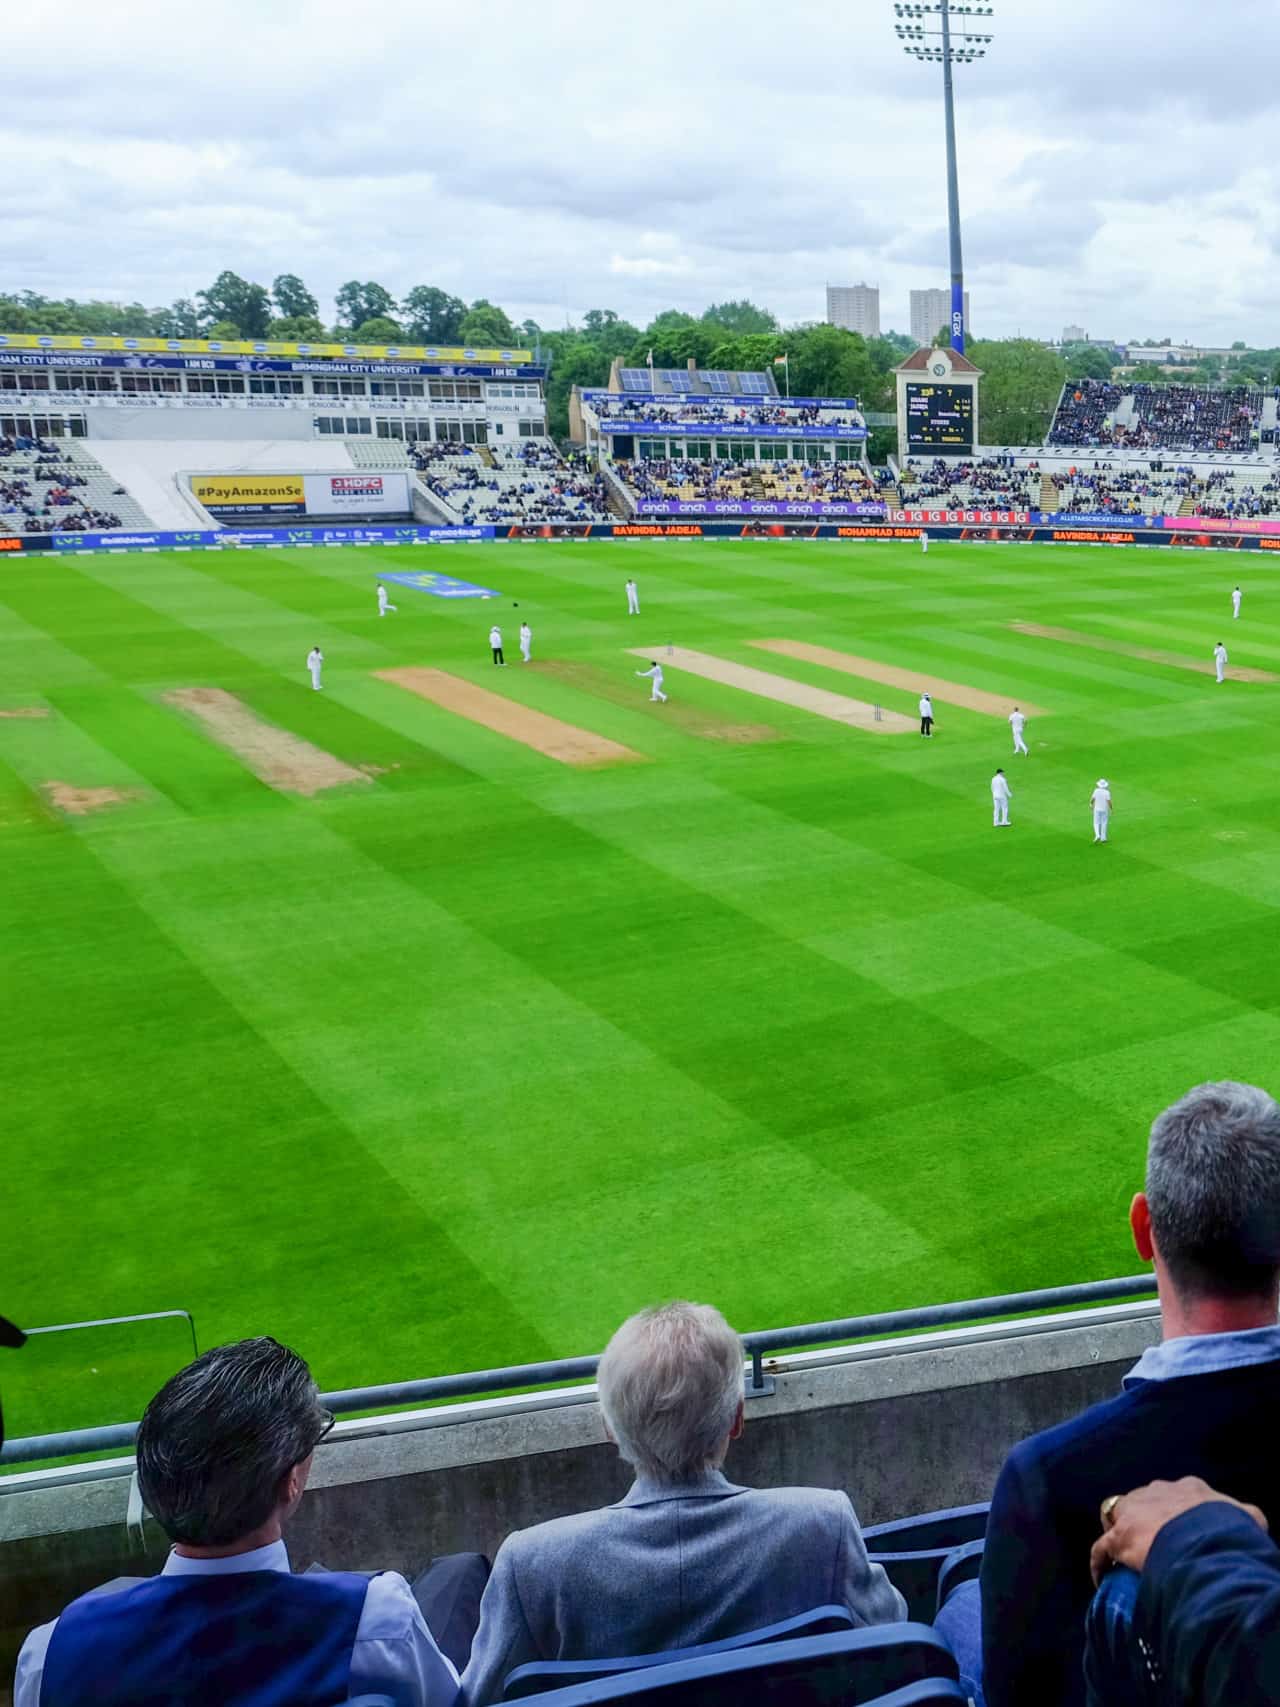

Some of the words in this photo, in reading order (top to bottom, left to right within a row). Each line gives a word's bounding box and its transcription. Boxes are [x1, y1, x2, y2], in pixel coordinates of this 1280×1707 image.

[952, 311, 962, 337] drax
[23, 356, 43, 365] CITY
[46, 356, 103, 366] UNIVERSITY
[291, 362, 348, 372] BIRMINGHAM
[350, 365, 370, 374] CITY
[371, 366, 421, 375] UNIVERSITY
[343, 478, 383, 488] HDFC
[197, 486, 302, 499] #PayAmazonSe
[642, 503, 670, 512] cinch
[679, 504, 706, 512] cinch
[715, 504, 742, 513] cinch
[751, 504, 778, 513] cinch
[786, 504, 813, 513] cinch
[822, 505, 848, 513] cinch
[856, 505, 882, 513] cinch
[893, 511, 905, 521] IG
[911, 511, 923, 521] IG
[928, 511, 940, 521] IG
[946, 511, 958, 521] IG
[963, 512, 975, 522] IG
[980, 512, 992, 522] IG
[998, 512, 1010, 522] IG
[1015, 513, 1026, 523] IG
[612, 526, 662, 535] RAVINDRA
[664, 527, 703, 535] JADEJA
[838, 528, 893, 537] MOHAMMAD
[1053, 531, 1099, 540] RAVINDRA
